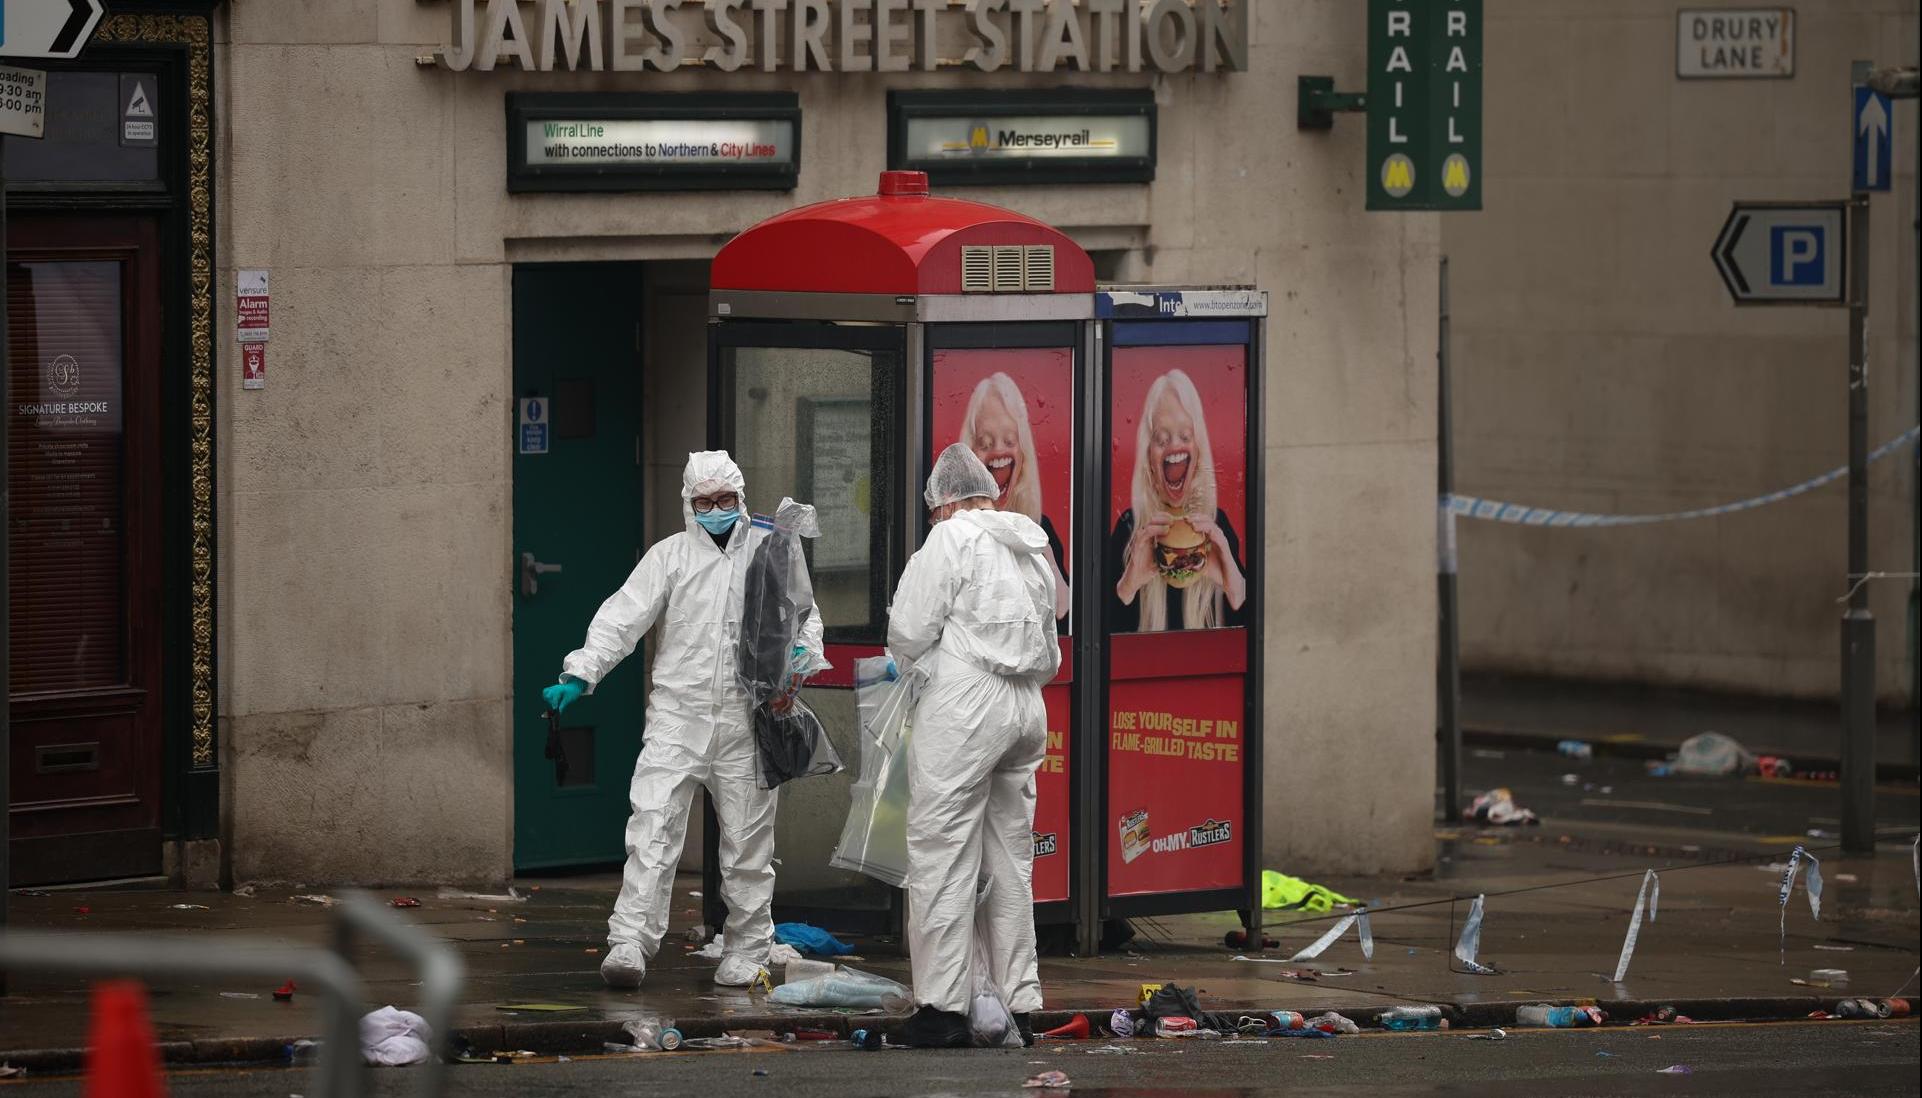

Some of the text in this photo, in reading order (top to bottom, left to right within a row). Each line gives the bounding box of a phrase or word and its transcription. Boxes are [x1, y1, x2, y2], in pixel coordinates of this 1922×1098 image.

[434, 0, 1248, 72] JAMES STREET STATION
[1693, 18, 1779, 40] DRURY
[1701, 47, 1762, 69] LANE
[1386, 0, 1412, 143] RAIL
[1446, 0, 1467, 143] RAIL
[25, 89, 41, 100] am
[25, 104, 41, 114] pm
[544, 123, 604, 138] Wirral Line
[1000, 129, 1090, 149] Merseyrail
[544, 142, 776, 159] with connections to Northern & City Lines
[1783, 231, 1817, 281] P
[240, 298, 268, 309] Alarm
[19, 401, 108, 415] SIGNATURE BESPOKE
[1113, 711, 1238, 739] LOSE YOURSELF IN
[1047, 731, 1063, 750] N
[1112, 732, 1239, 761] FLAME-GRILLED TASTE
[1191, 822, 1231, 847] RUSTLERS
[1033, 835, 1056, 856] LERS
